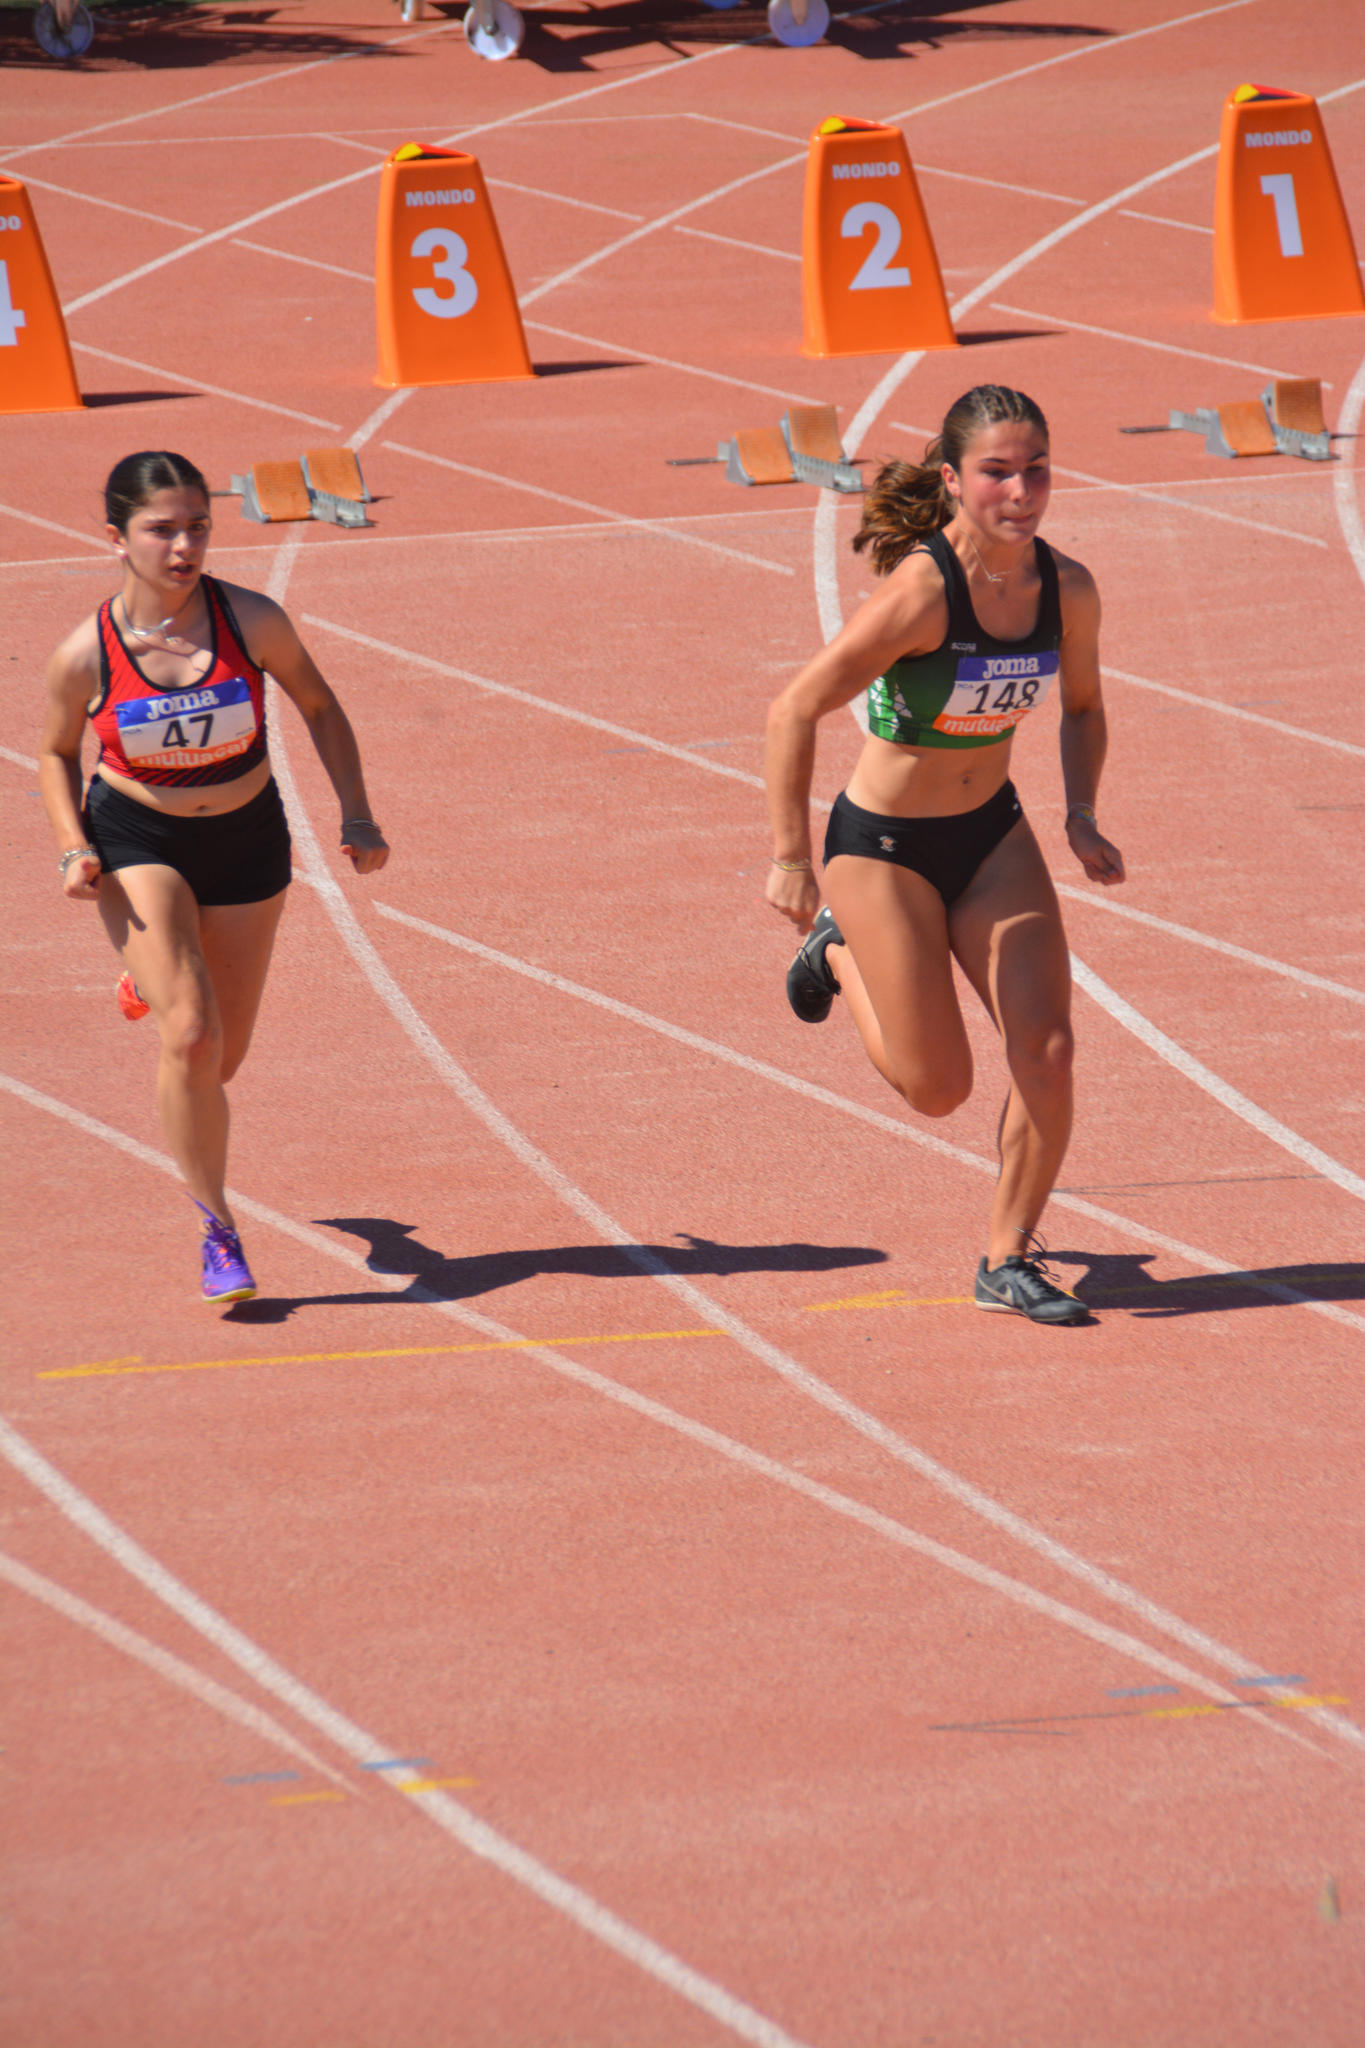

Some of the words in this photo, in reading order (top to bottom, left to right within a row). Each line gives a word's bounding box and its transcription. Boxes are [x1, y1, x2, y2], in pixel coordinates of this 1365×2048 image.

[1245, 130, 1313, 148] MONDO
[832, 161, 901, 179] MONDO
[405, 188, 476, 207] MONDO
[1260, 173, 1304, 257] 1
[840, 201, 912, 291] 2
[411, 227, 479, 319] 3
[966, 679, 1040, 715] 148
[162, 713, 214, 748] 47
